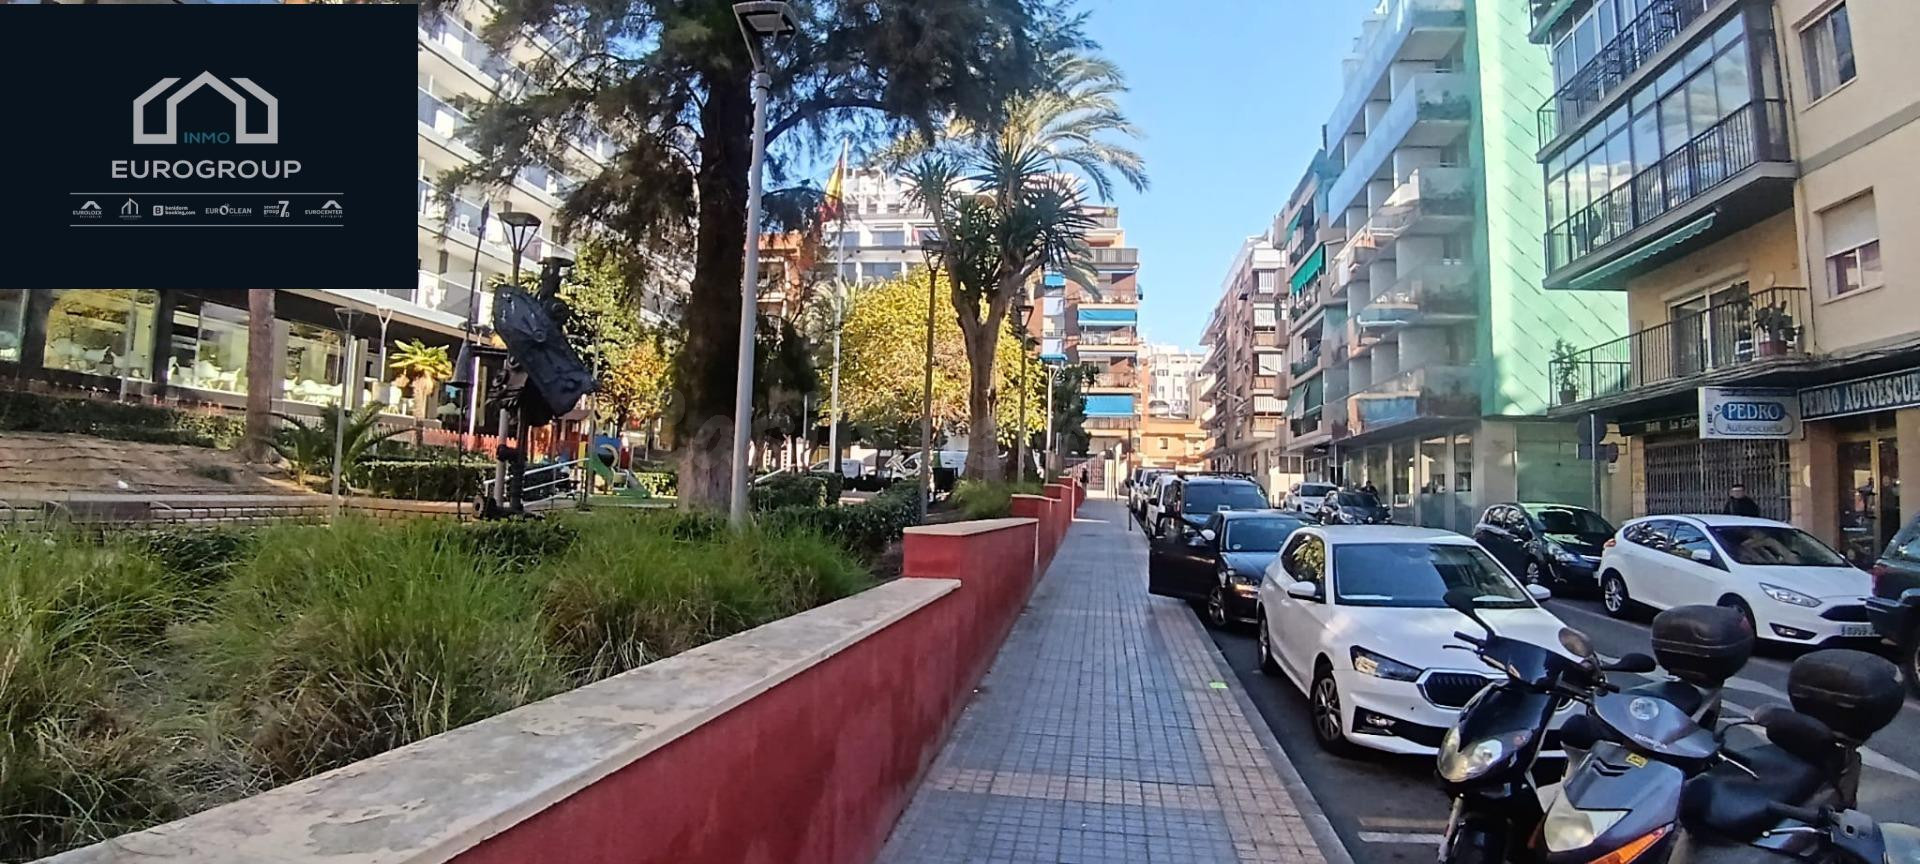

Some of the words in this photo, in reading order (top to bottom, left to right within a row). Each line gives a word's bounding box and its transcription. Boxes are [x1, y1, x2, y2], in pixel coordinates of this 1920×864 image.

[1800, 387, 1839, 416] PEDRO
[1844, 373, 1920, 411] AUTOESCUE
[1727, 403, 1779, 420] PEDRO
[1725, 423, 1783, 433] Autoescuela
